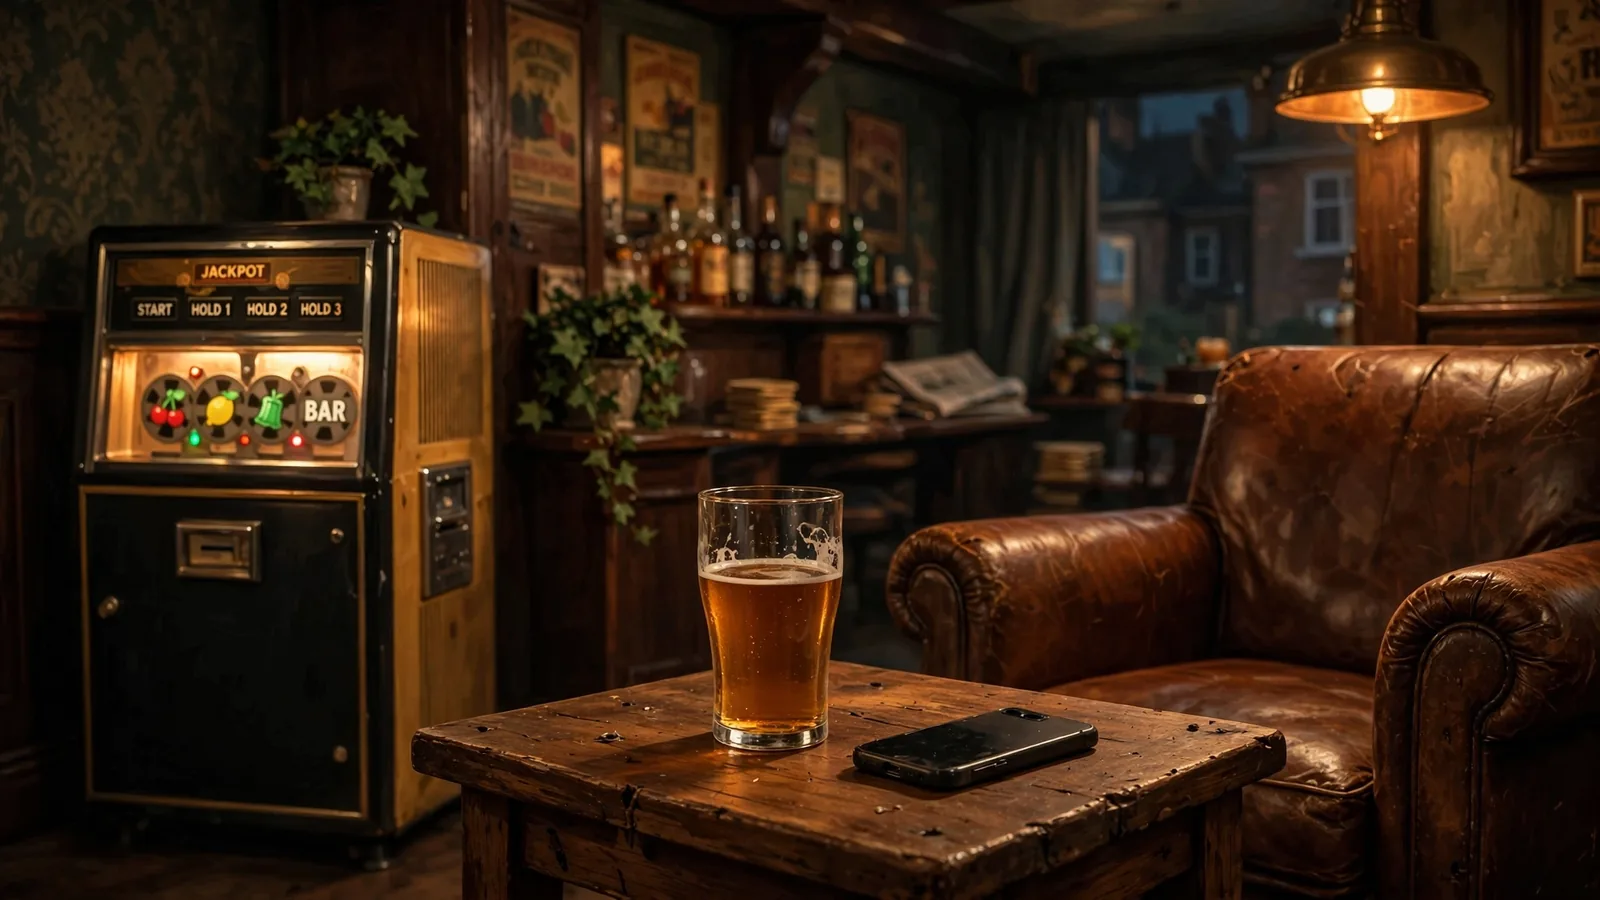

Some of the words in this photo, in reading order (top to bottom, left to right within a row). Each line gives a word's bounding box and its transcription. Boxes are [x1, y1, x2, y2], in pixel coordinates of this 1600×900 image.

[201, 264, 265, 278] JACKPOT
[137, 303, 173, 316] START
[191, 303, 222, 316] HOLD
[225, 303, 231, 316] 1
[247, 303, 277, 316] HOLD
[280, 303, 288, 316] 2
[301, 303, 331, 316] HOLD
[334, 303, 342, 316] 3
[304, 400, 346, 422] BAR
